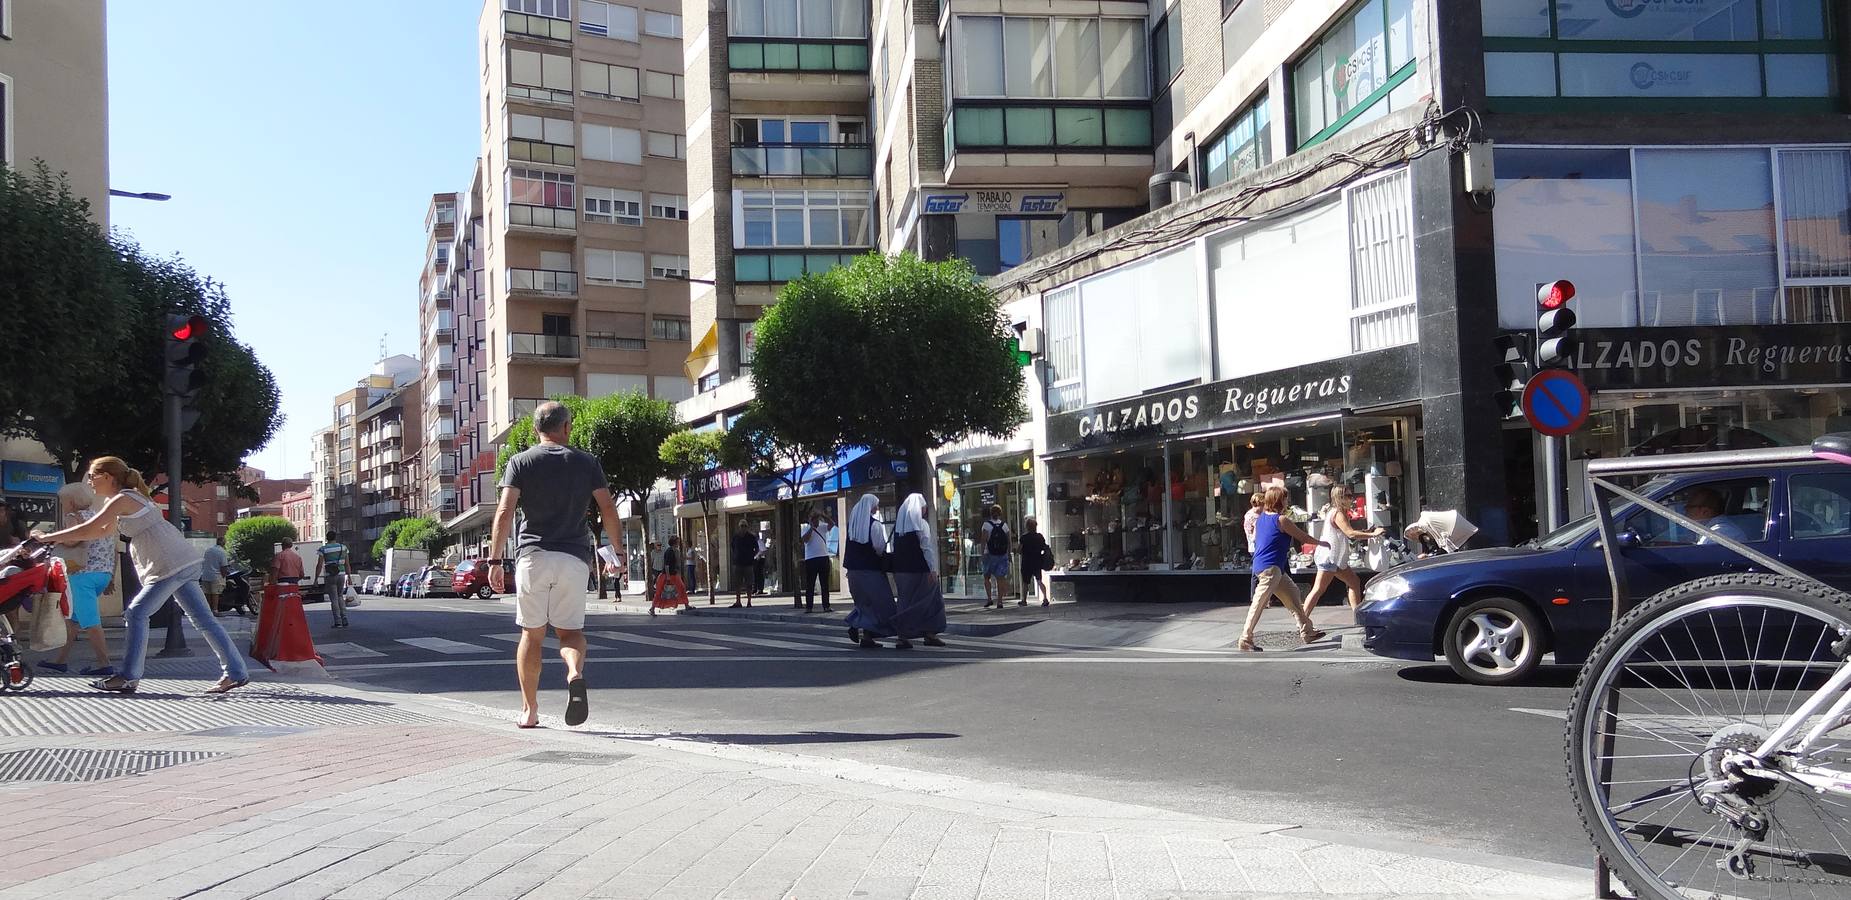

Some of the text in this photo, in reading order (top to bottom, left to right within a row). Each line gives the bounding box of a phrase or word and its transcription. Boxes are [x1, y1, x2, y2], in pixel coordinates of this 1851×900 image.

[976, 191, 1012, 203] TRABAJO
[977, 202, 1012, 211] TEMPORAL
[1567, 339, 1702, 369] LZADOS
[1079, 374, 1350, 439] CALZADOS Regueras
